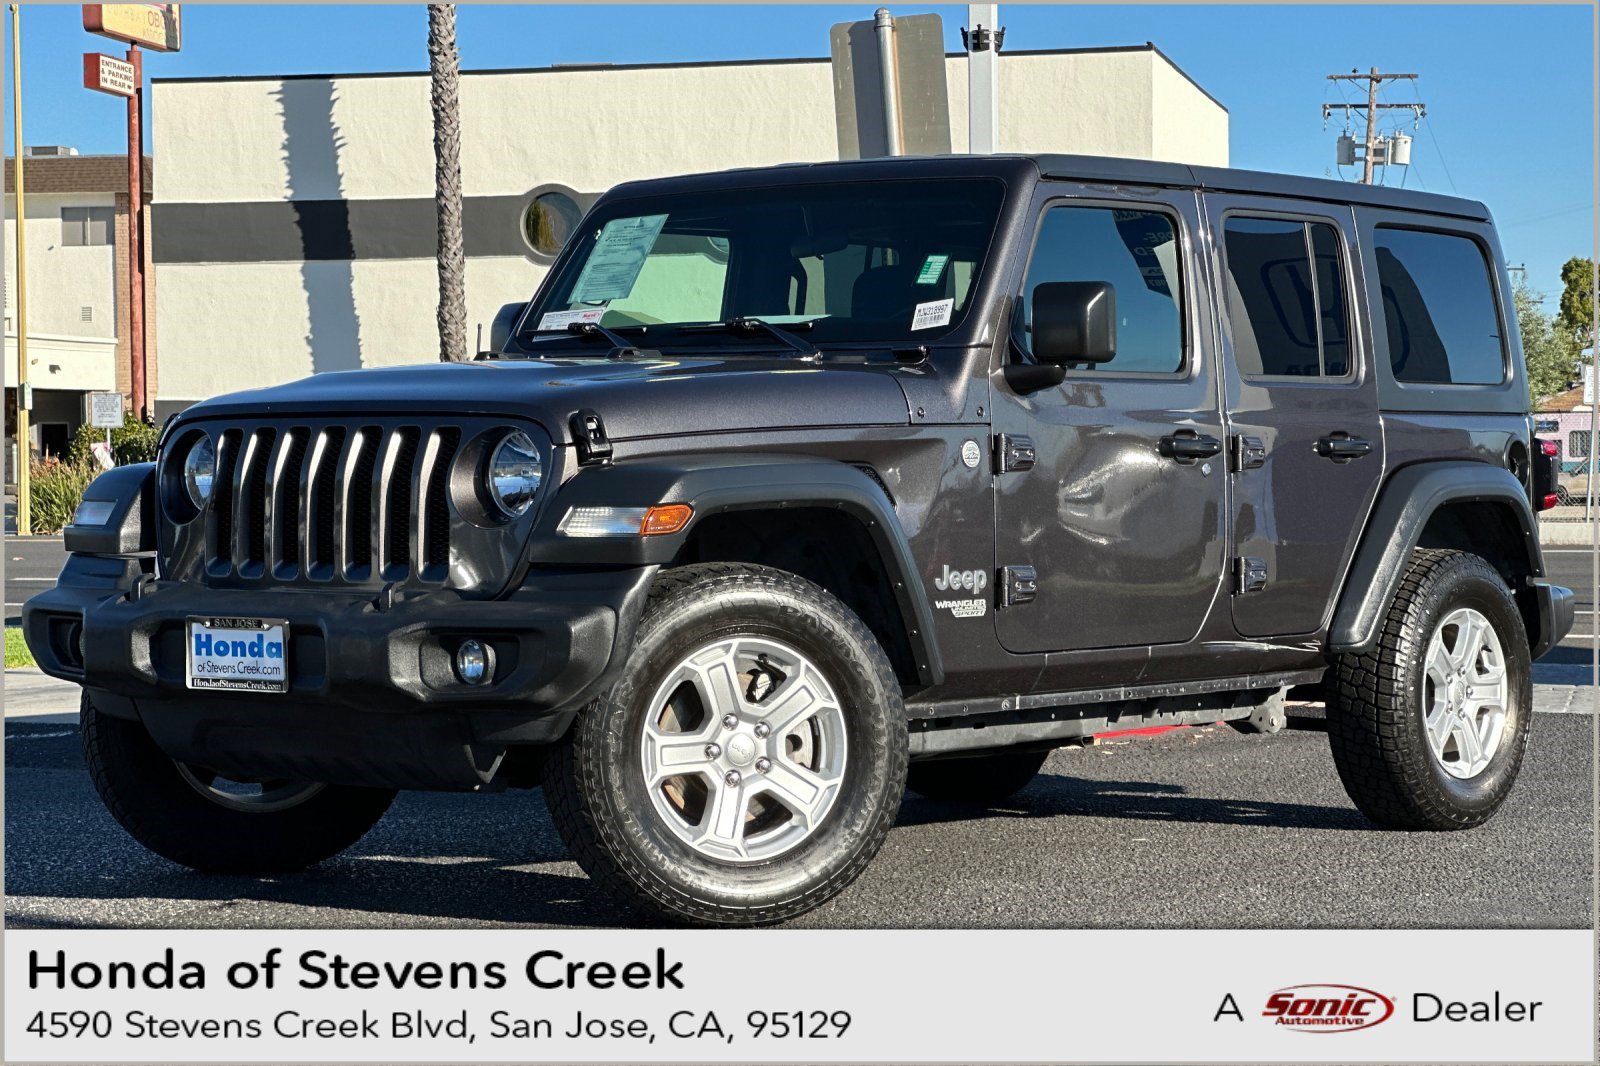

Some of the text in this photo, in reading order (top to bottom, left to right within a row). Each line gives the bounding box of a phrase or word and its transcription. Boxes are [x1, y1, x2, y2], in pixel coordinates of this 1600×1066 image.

[102, 60, 132, 74] ENTRANCE
[108, 70, 133, 82] PARKING
[110, 79, 126, 88] REAR
[934, 564, 987, 594] Jeep
[934, 598, 986, 608] WRANGLER
[214, 618, 259, 628] SAN JOSE
[194, 633, 282, 658] Honda
[197, 660, 280, 675] of Stevens Creek.com
[193, 679, 282, 691] HondaofStevensCreek.com
